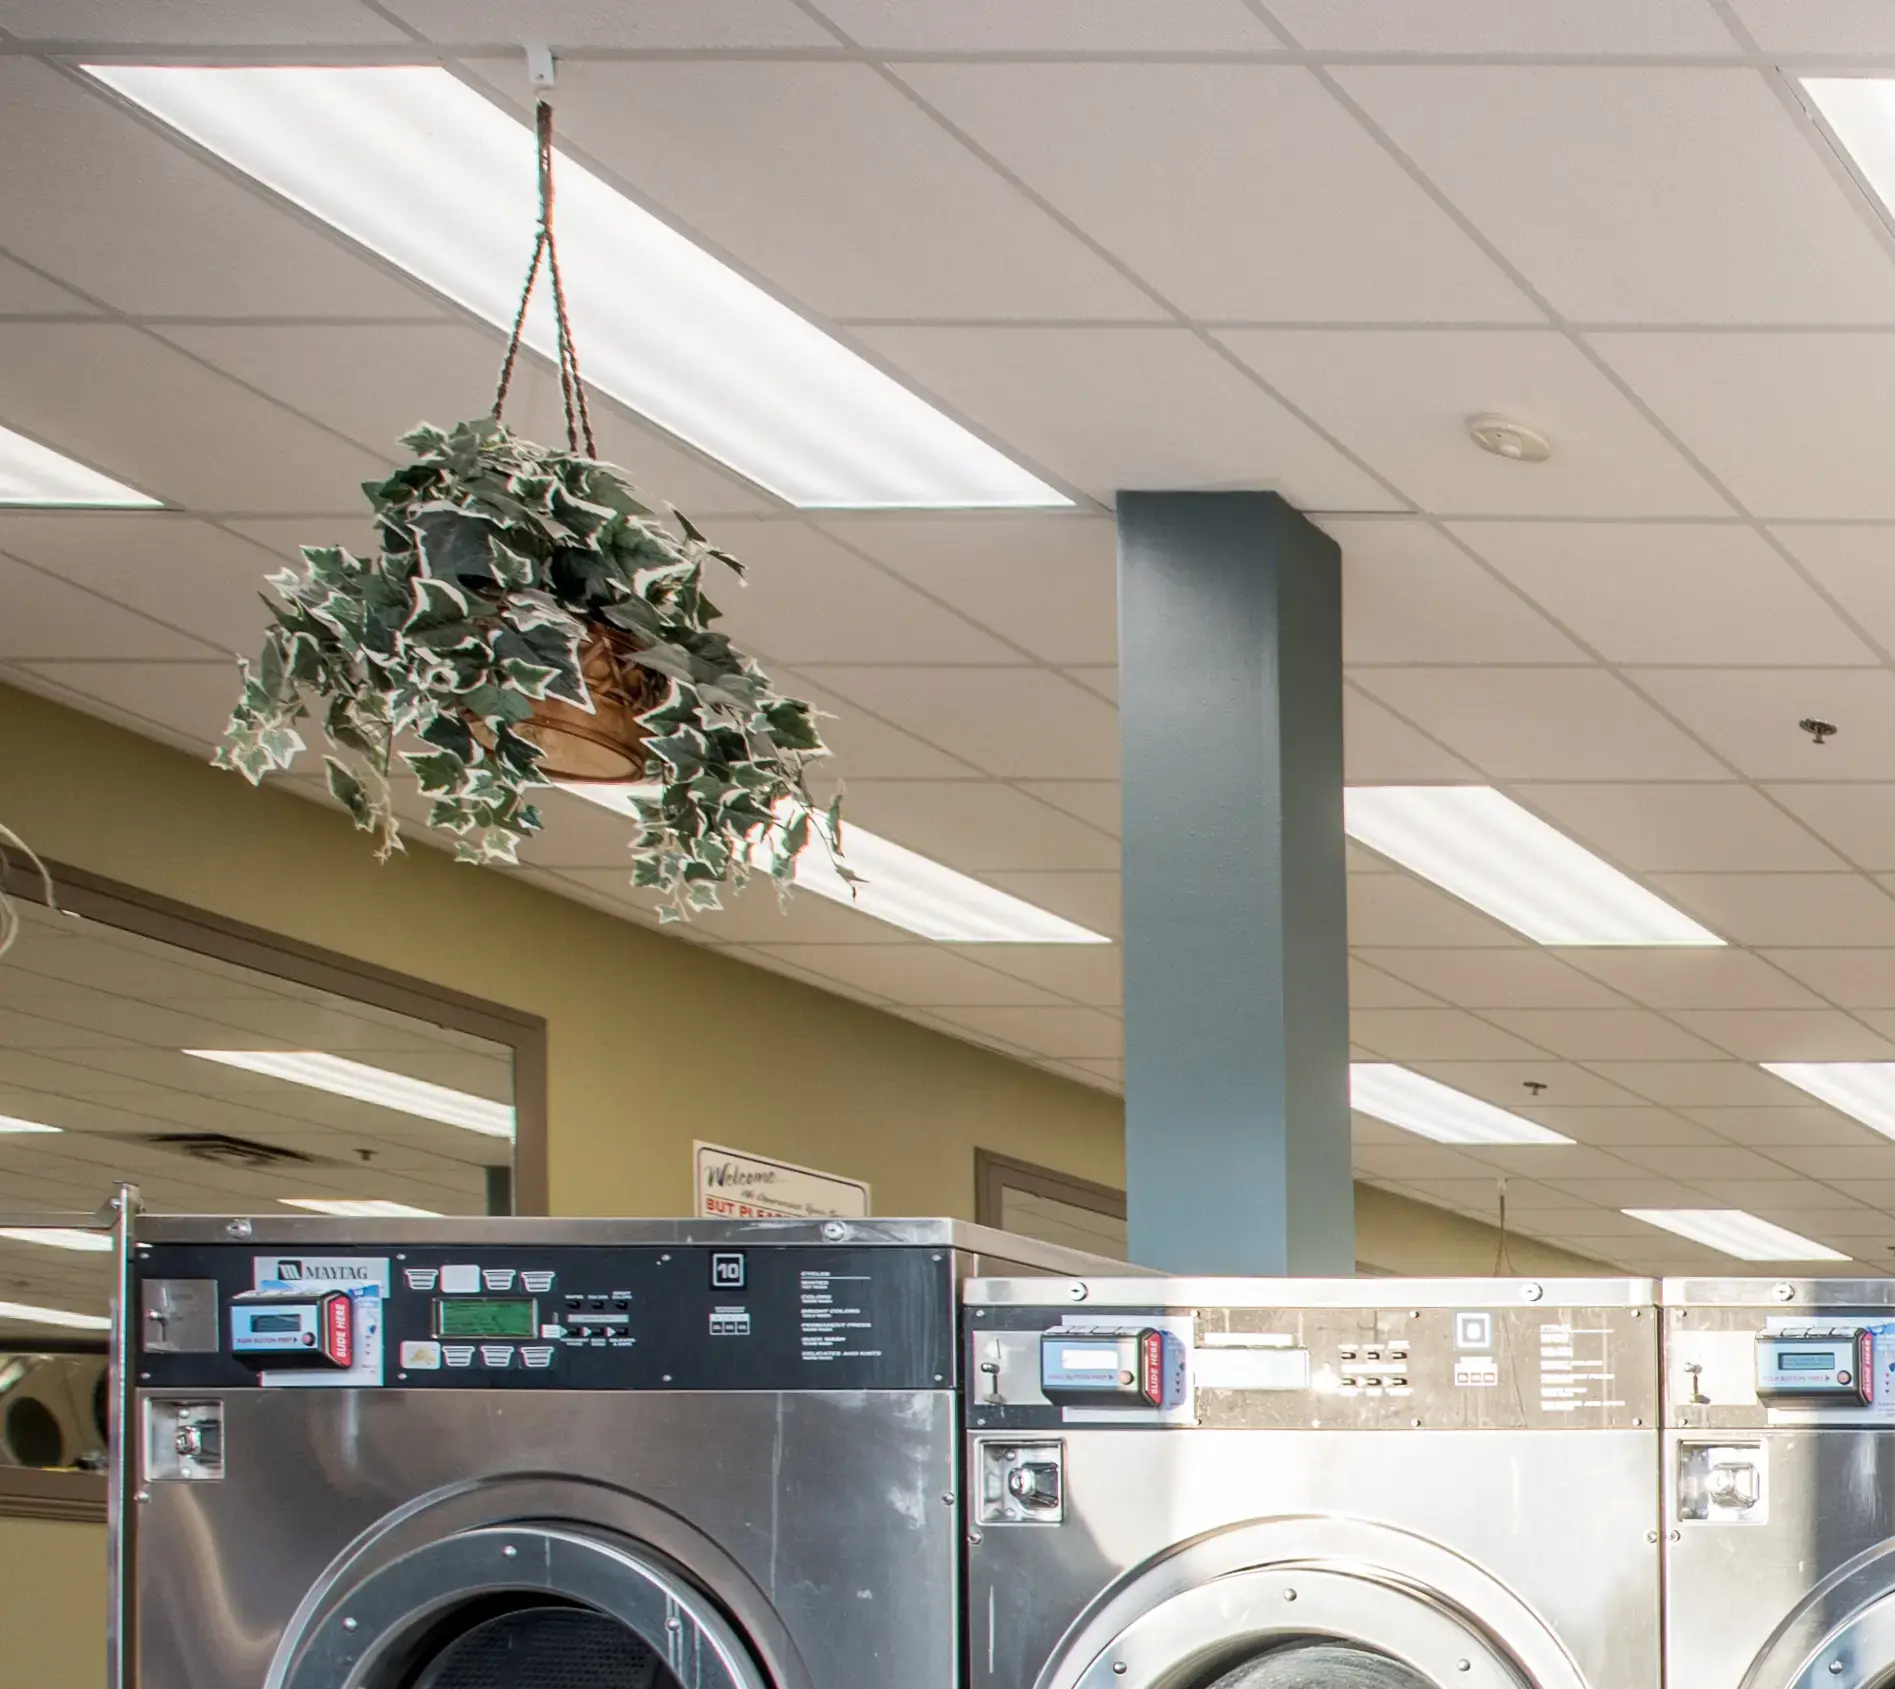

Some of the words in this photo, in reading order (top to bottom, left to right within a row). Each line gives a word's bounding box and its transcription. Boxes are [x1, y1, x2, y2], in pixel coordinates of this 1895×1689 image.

[706, 1197, 735, 1214] BUT
[305, 1266, 368, 1280] MAYTAG
[717, 1263, 739, 1279] 10
[335, 1303, 346, 1330] HERE
[336, 1330, 347, 1358] SLIDE
